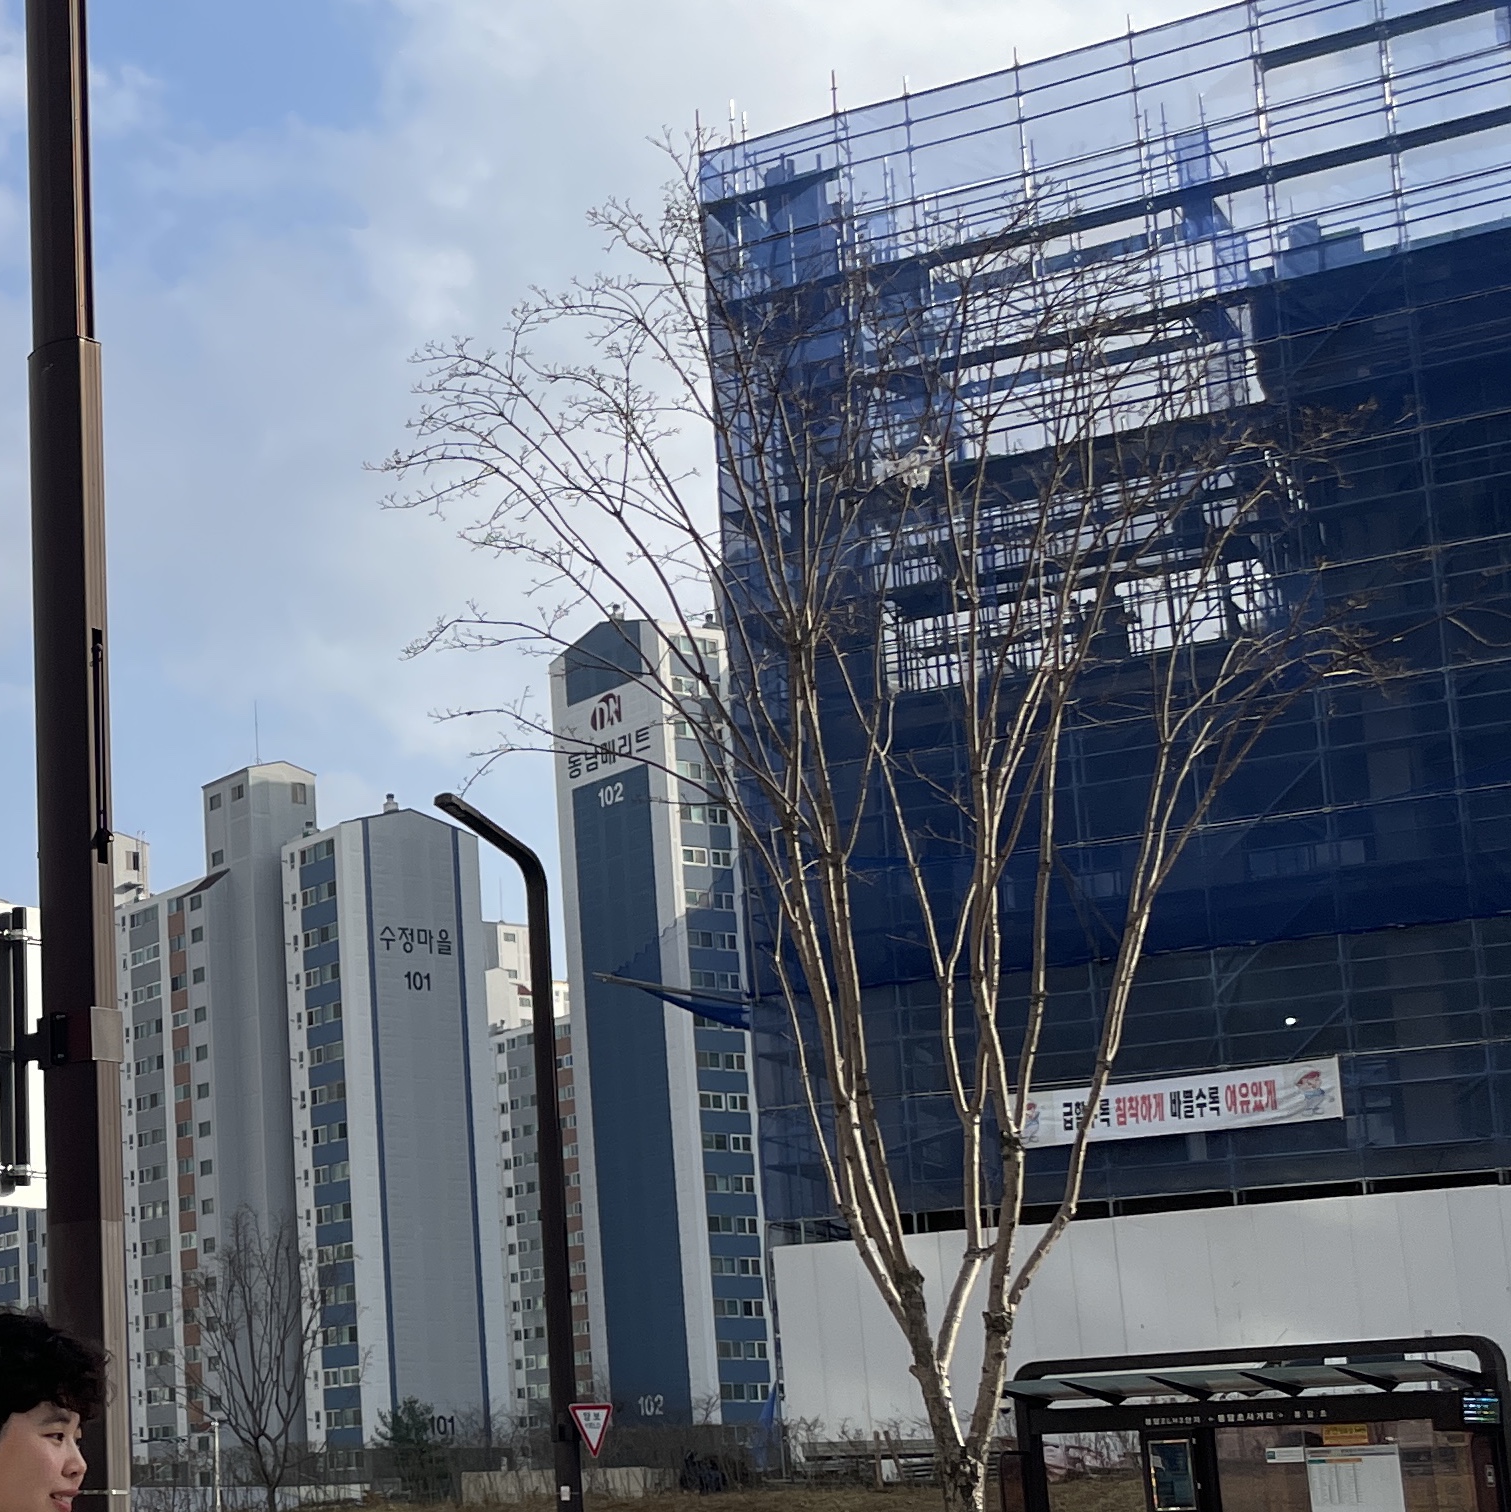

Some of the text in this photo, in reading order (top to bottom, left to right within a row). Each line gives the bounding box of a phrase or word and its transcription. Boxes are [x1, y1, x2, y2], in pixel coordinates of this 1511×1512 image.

[597, 782, 624, 808] 102
[379, 926, 452, 955] 수정마을
[404, 971, 431, 991] 101
[1115, 1092, 1165, 1126] 침착하게
[1170, 1085, 1220, 1119] 바쁠수록
[1225, 1079, 1278, 1114] 여유있게
[638, 1394, 664, 1416] 102
[429, 1415, 455, 1435] 101
